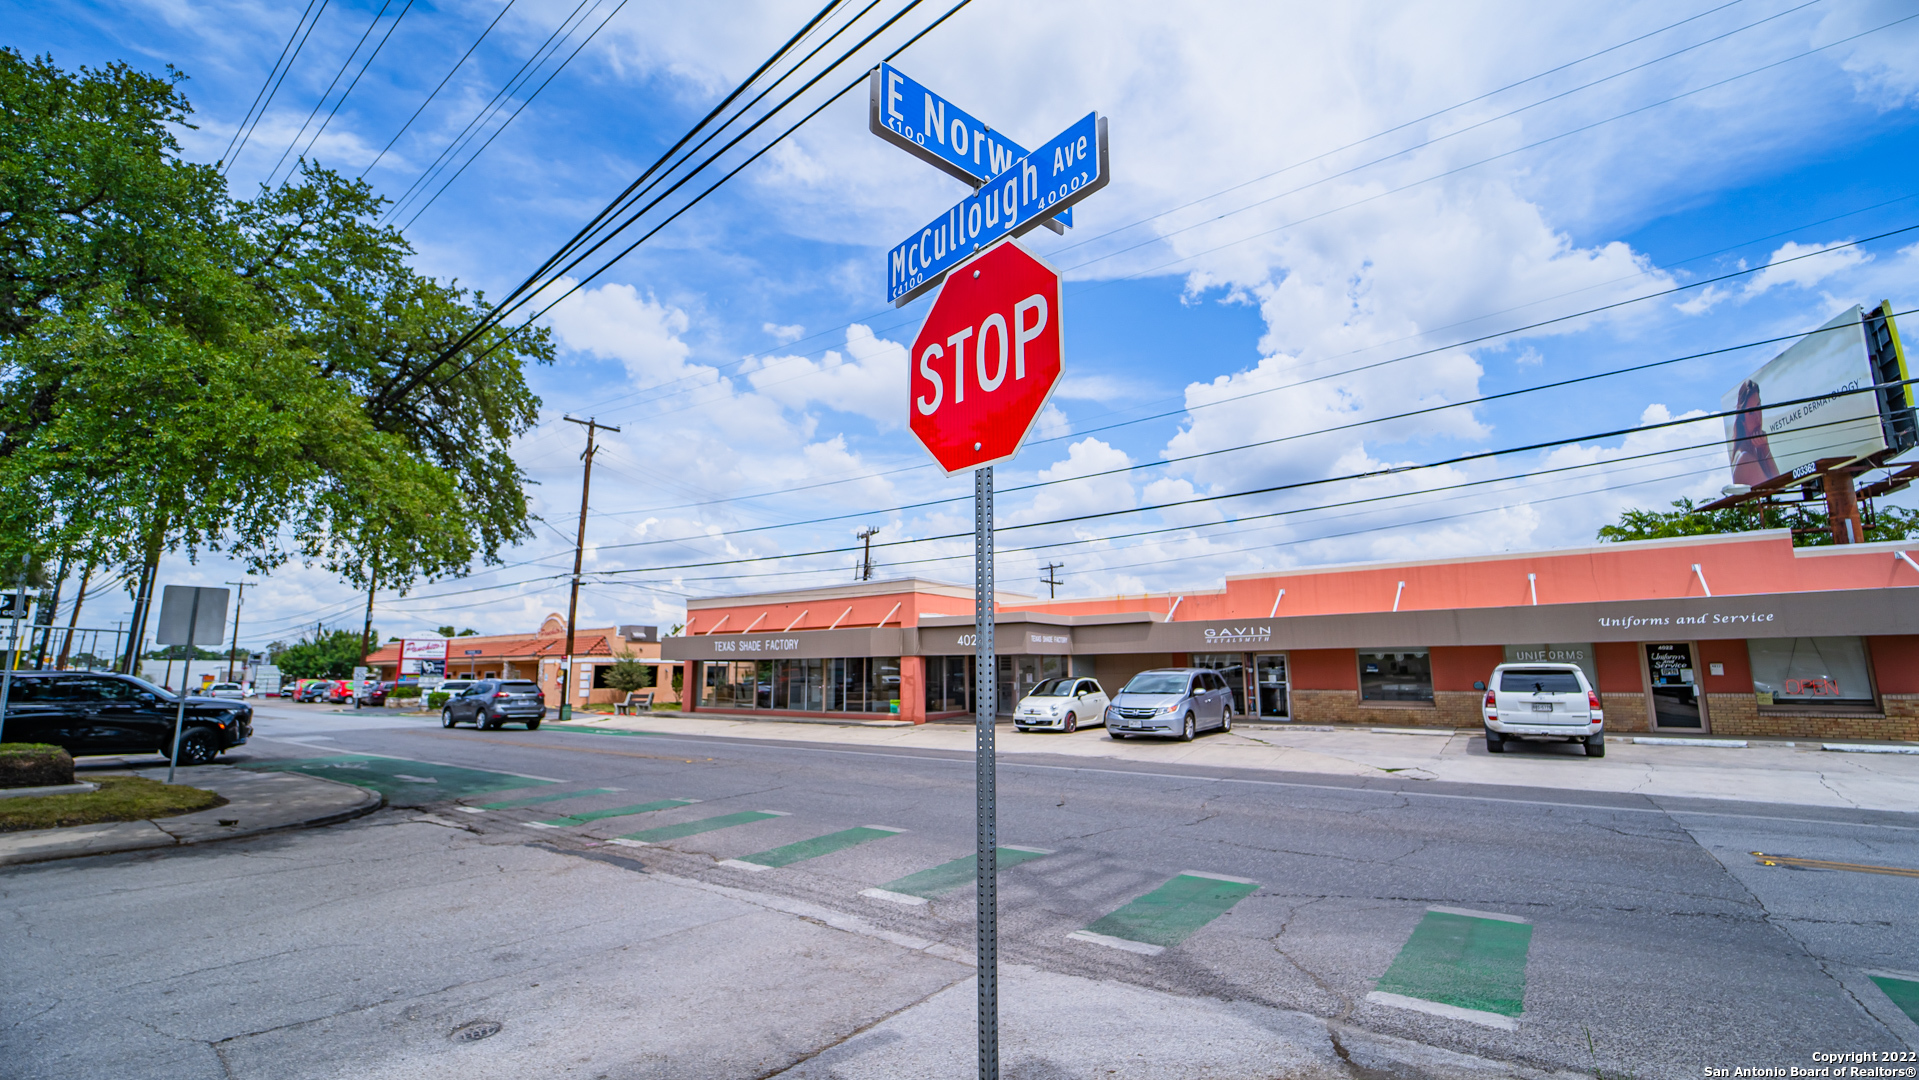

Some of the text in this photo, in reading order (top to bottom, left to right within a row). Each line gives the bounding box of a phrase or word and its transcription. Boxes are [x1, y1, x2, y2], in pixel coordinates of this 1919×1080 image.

[888, 70, 1023, 175] E Norw
[892, 135, 1087, 287] McCullough Ave
[917, 293, 1048, 416] STOP
[1769, 410, 1802, 432] WESTLAKE
[1792, 462, 1817, 479] 003362
[1599, 611, 1774, 629] Uniforms and Service
[1204, 626, 1271, 637] GAVIN
[714, 639, 799, 652] TEXAS SHADE FACTORY
[1516, 650, 1584, 660] UNIFORMS
[1651, 652, 1685, 660] Uniforms
[1654, 660, 1687, 669] Service
[1785, 679, 1839, 695] OPEN
